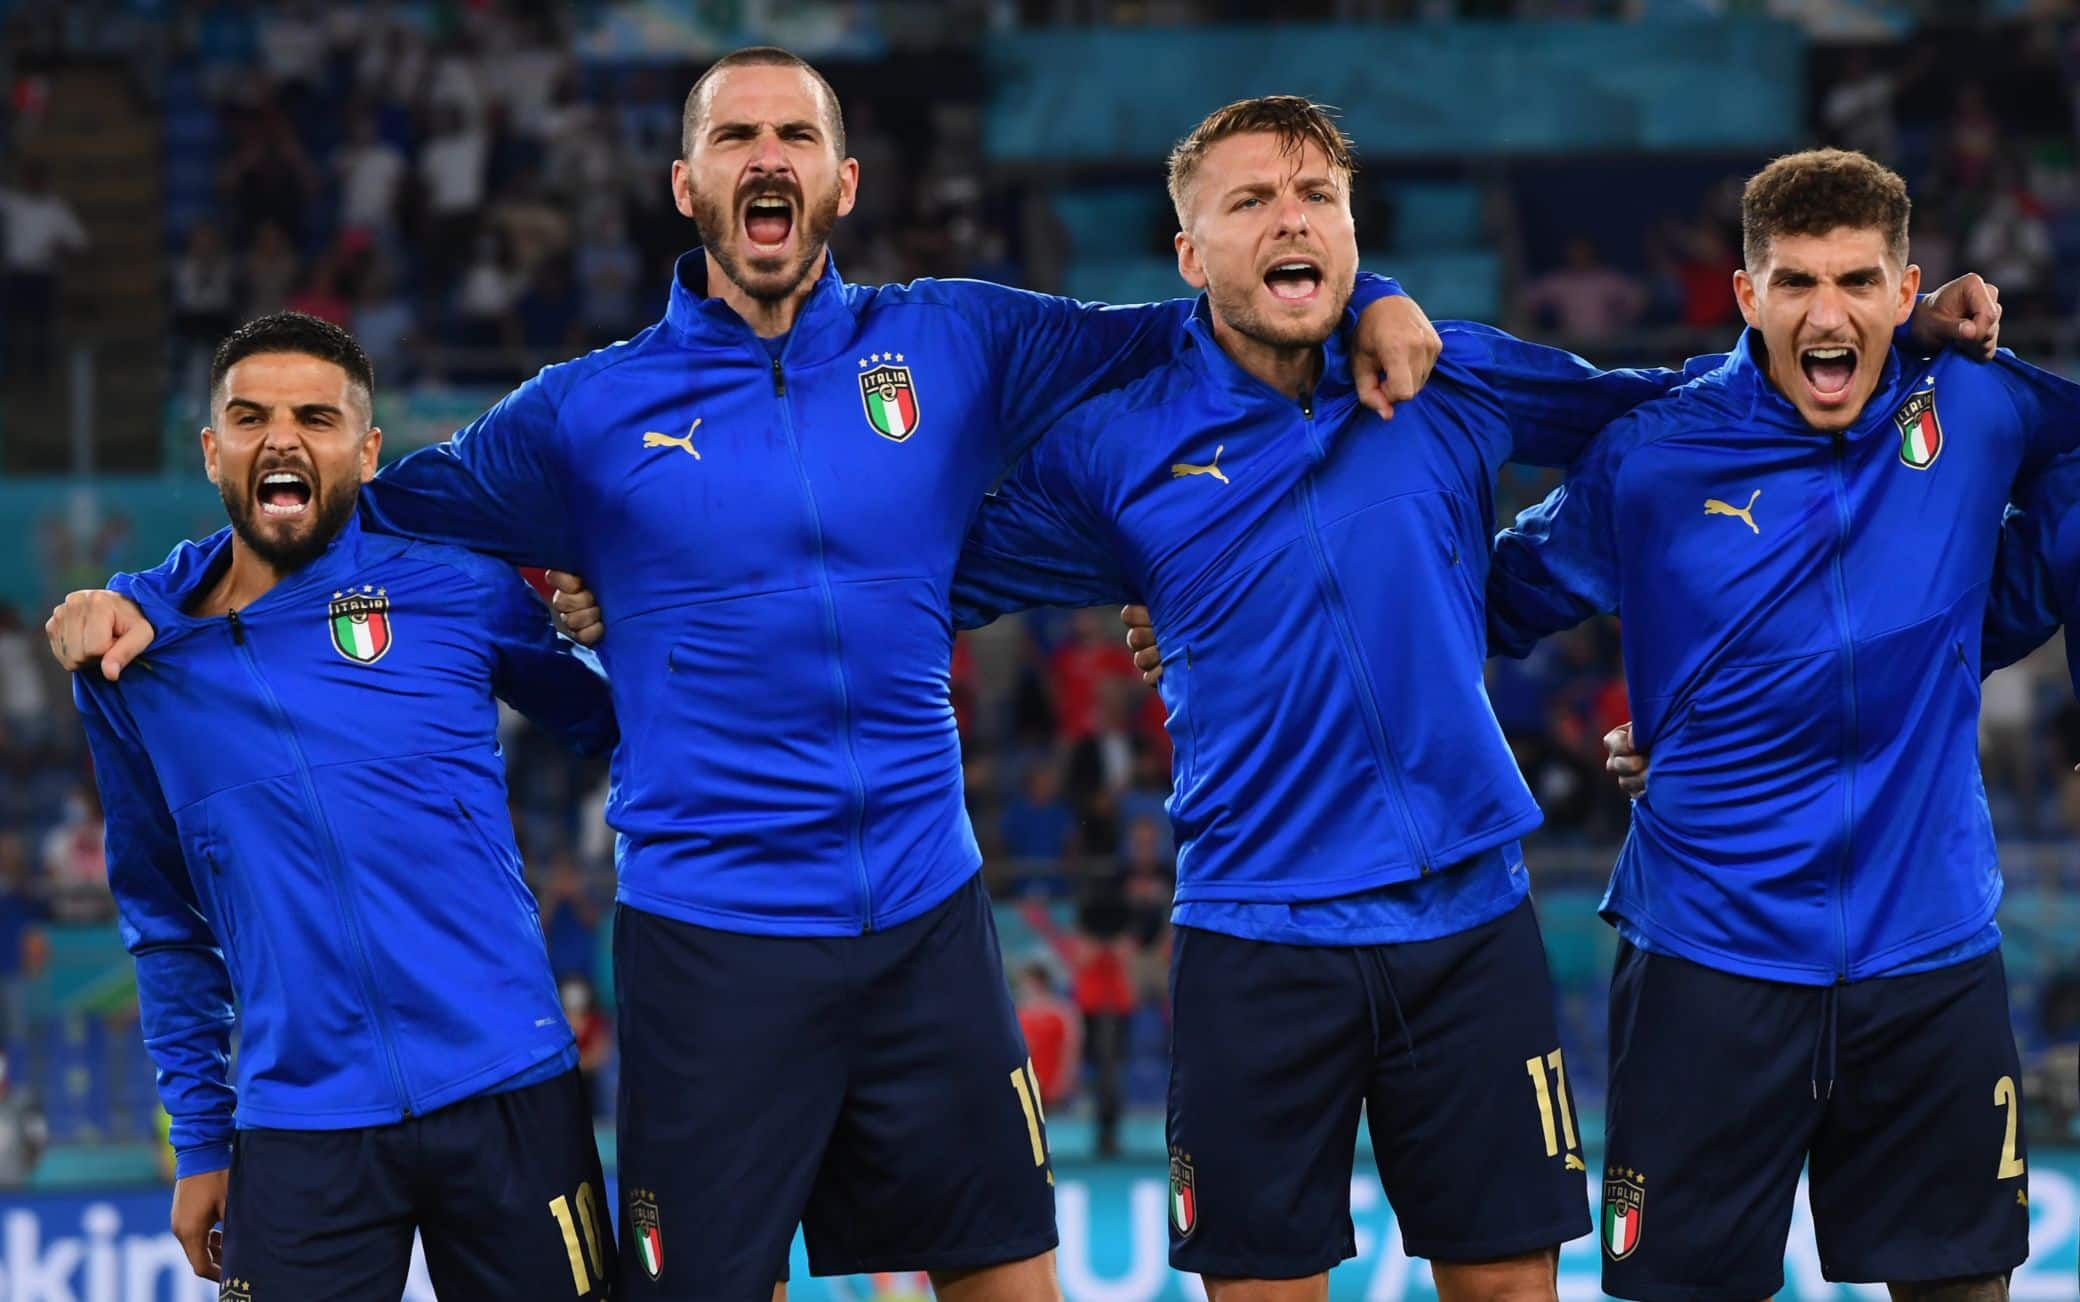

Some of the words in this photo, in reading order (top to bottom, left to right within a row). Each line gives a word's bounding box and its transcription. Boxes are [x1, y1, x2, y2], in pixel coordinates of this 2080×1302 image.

[864, 371, 907, 388] ITALIA
[1898, 394, 1932, 420] ITALIA
[335, 600, 384, 613] ITALIA
[1009, 1056, 1046, 1167] 1
[1526, 1047, 1577, 1157] 11
[1993, 1075, 2025, 1179] 2
[1607, 1186, 1641, 1204] ITALIA
[548, 1181, 603, 1296] 10
